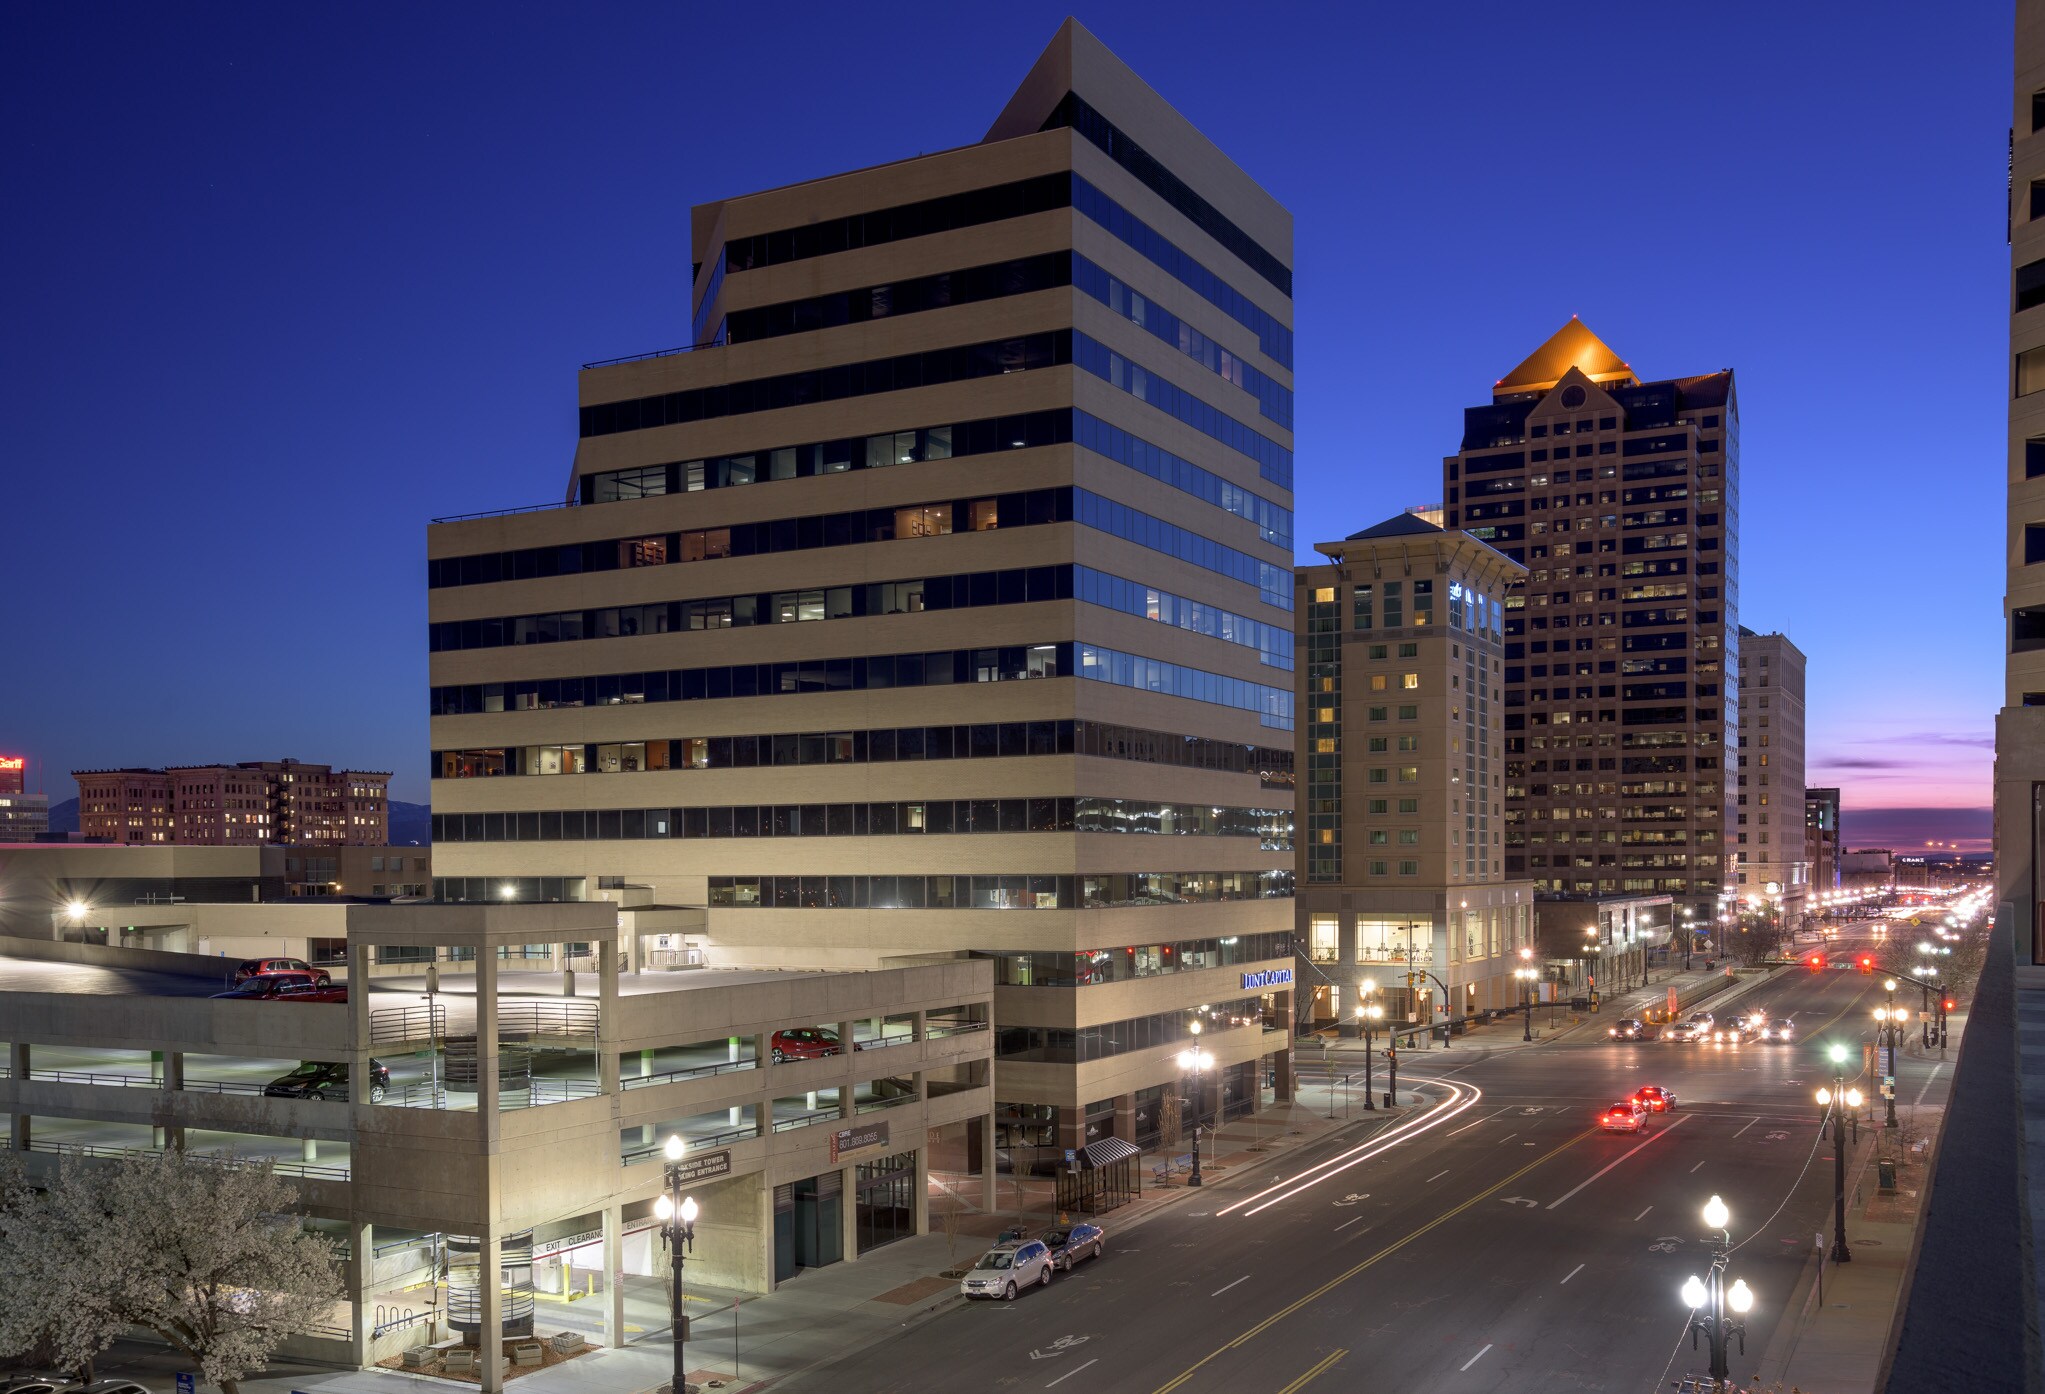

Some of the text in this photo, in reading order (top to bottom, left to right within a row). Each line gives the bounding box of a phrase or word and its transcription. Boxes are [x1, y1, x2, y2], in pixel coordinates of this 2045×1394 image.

[1244, 968, 1293, 990] LUNT CAPITAL
[838, 1130, 851, 1138] CBRE
[703, 1155, 724, 1166] TOWER
[697, 1163, 728, 1176] ENTRANCE
[546, 1240, 561, 1252] EXIT
